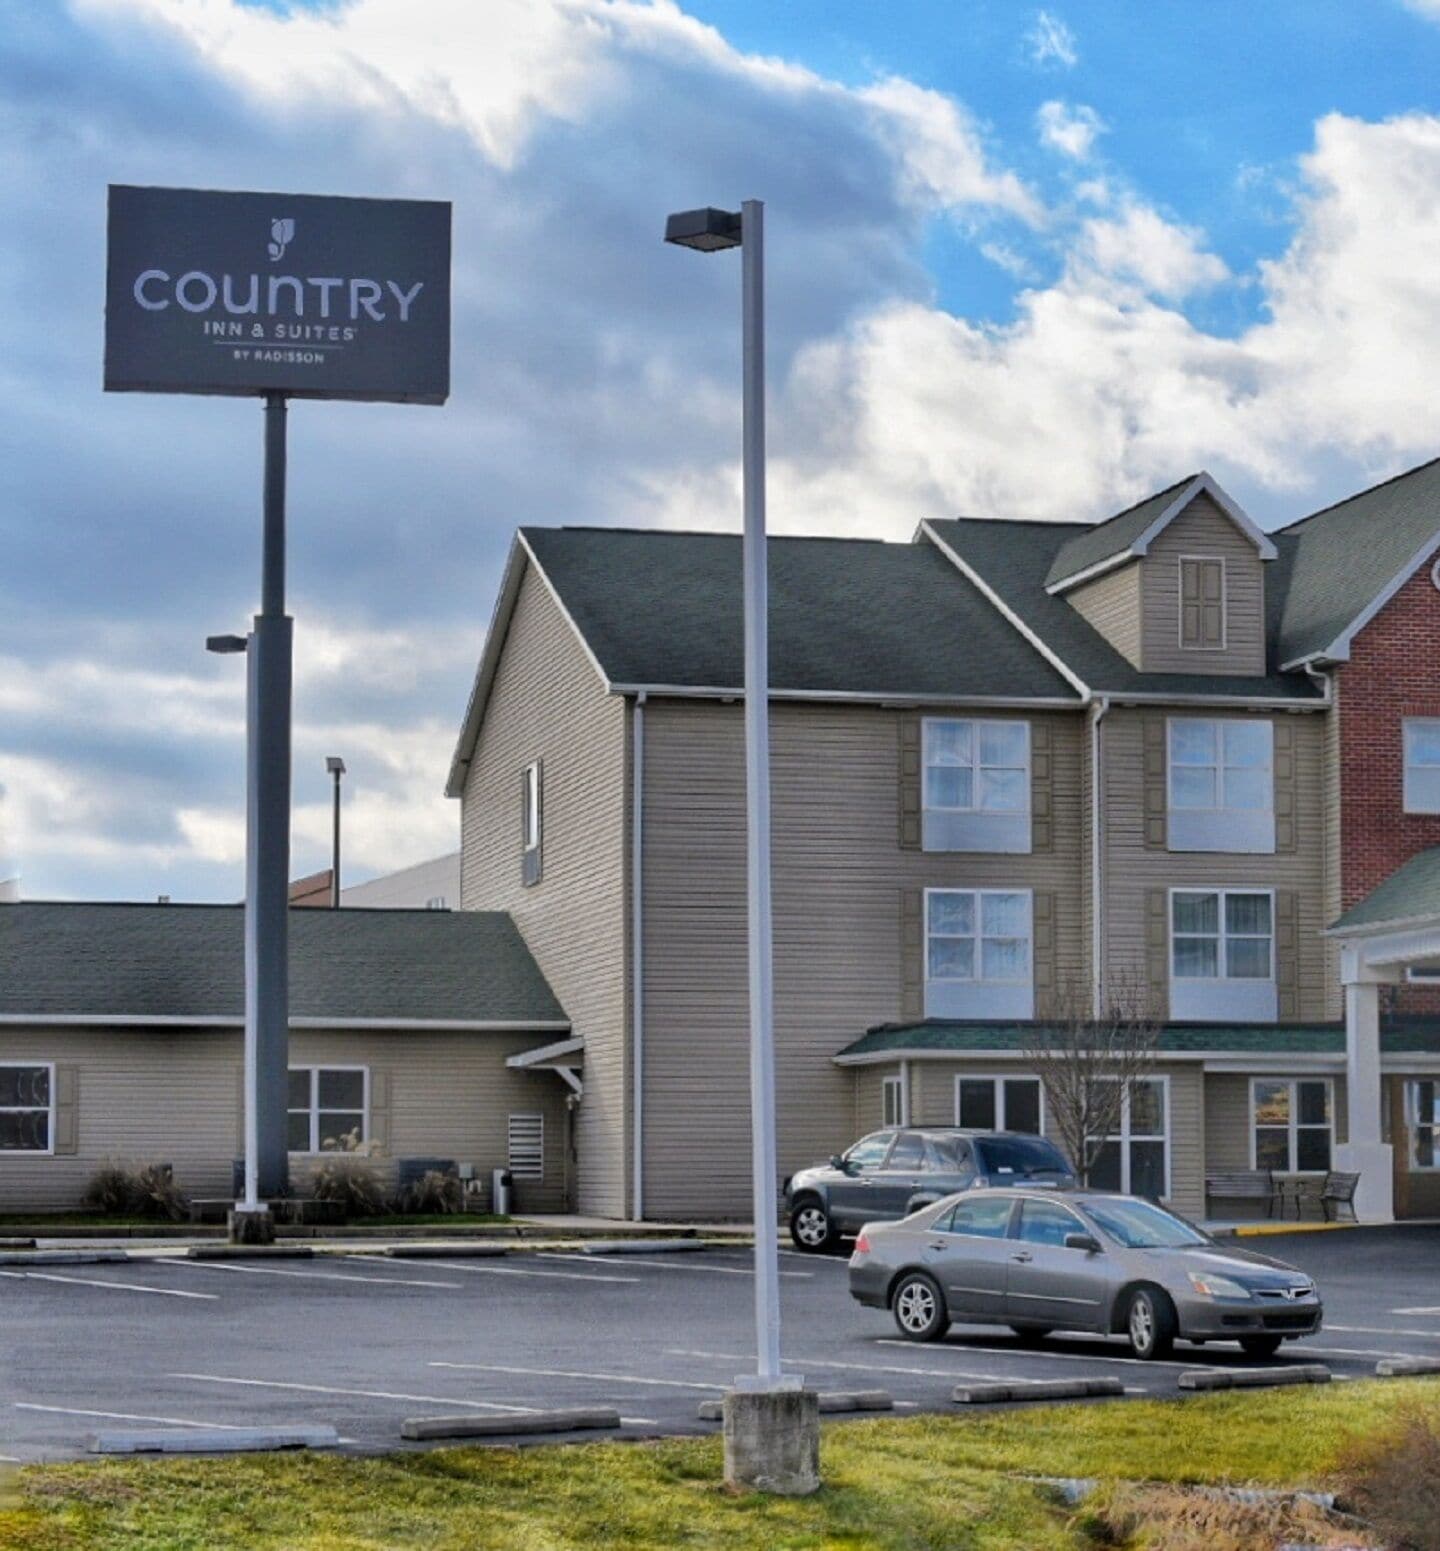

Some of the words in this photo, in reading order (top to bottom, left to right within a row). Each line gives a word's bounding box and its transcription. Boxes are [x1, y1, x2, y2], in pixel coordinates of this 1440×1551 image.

[205, 320, 243, 336] INN
[251, 322, 264, 338] &
[275, 324, 355, 341] SUITES
[233, 350, 249, 361] BY
[254, 350, 325, 364] RADISSON
